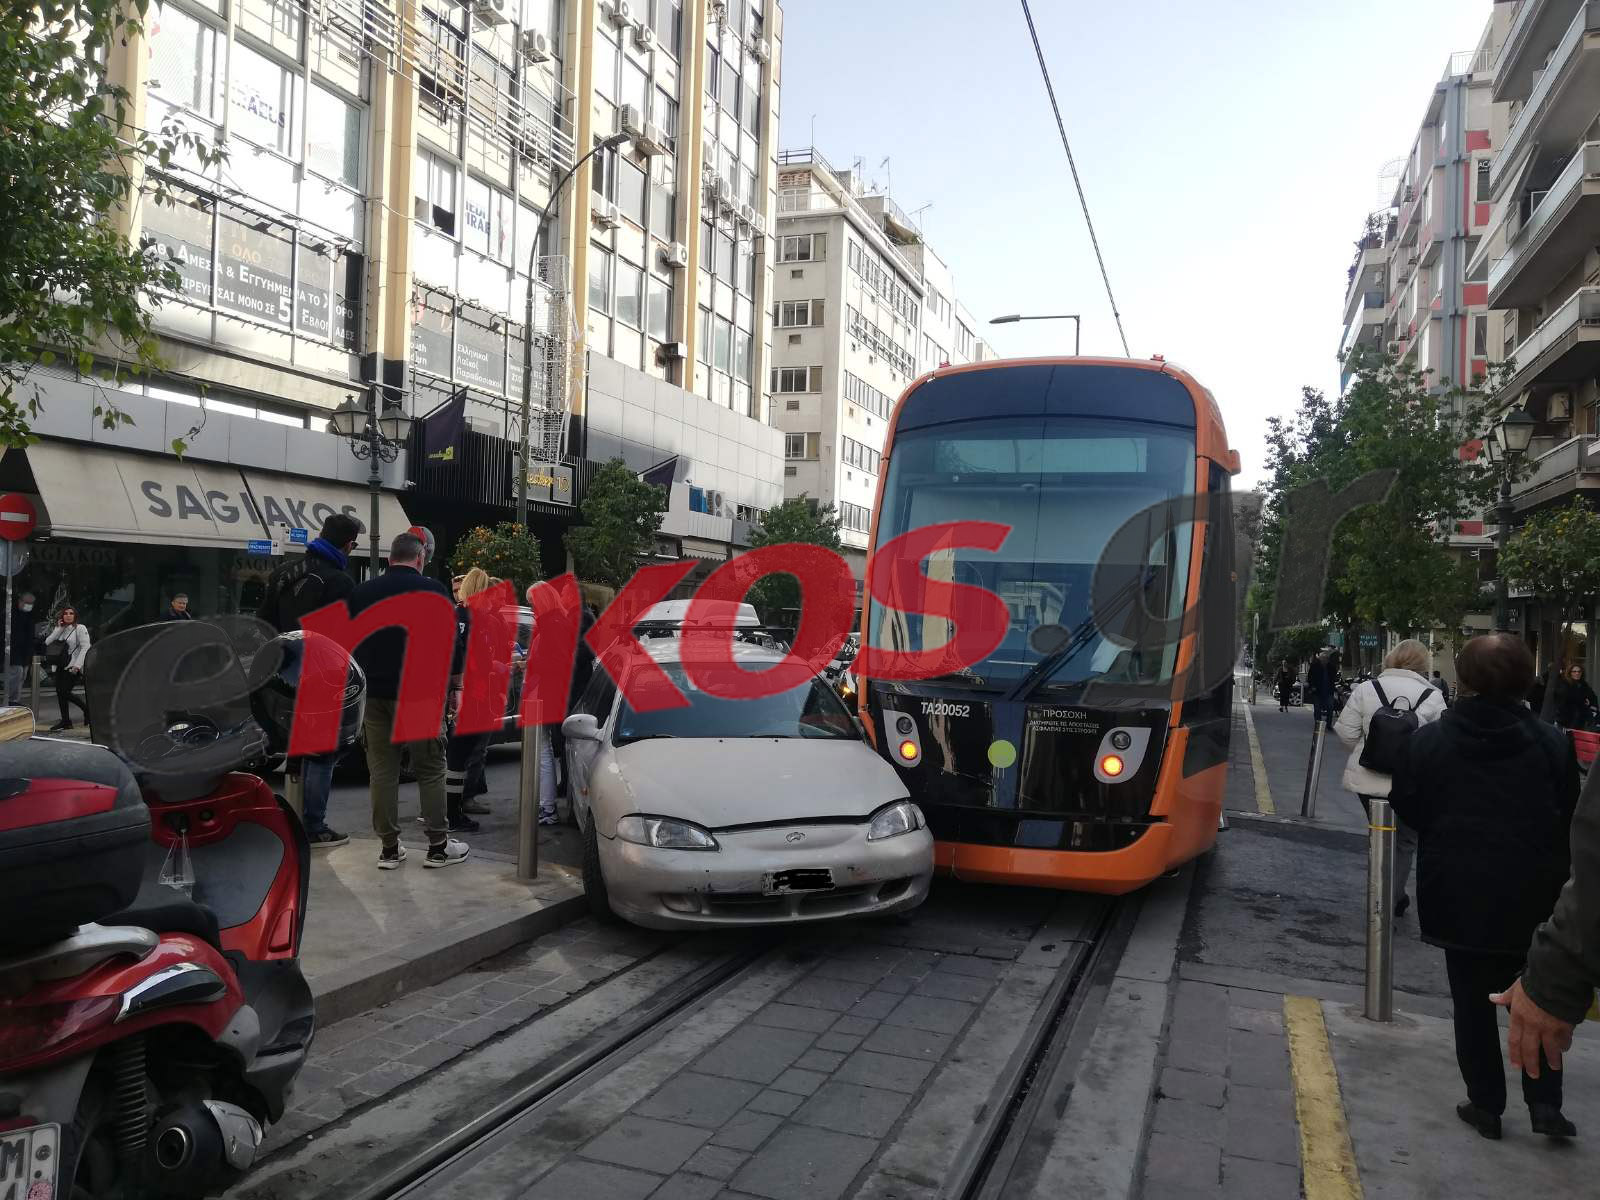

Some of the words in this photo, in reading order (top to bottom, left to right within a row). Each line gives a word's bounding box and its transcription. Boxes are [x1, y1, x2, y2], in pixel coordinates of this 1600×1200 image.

[237, 293, 264, 311] ΜΟΝΟ
[264, 303, 276, 315] ΣΕ
[277, 295, 291, 323] 5
[301, 308, 355, 342] ΕΒΔΟΑΔΕΣ
[141, 480, 367, 534] SAGIAKOS
[920, 701, 970, 717] TA20052
[1043, 709, 1087, 719] ΠΡΟΣΟΧΗ
